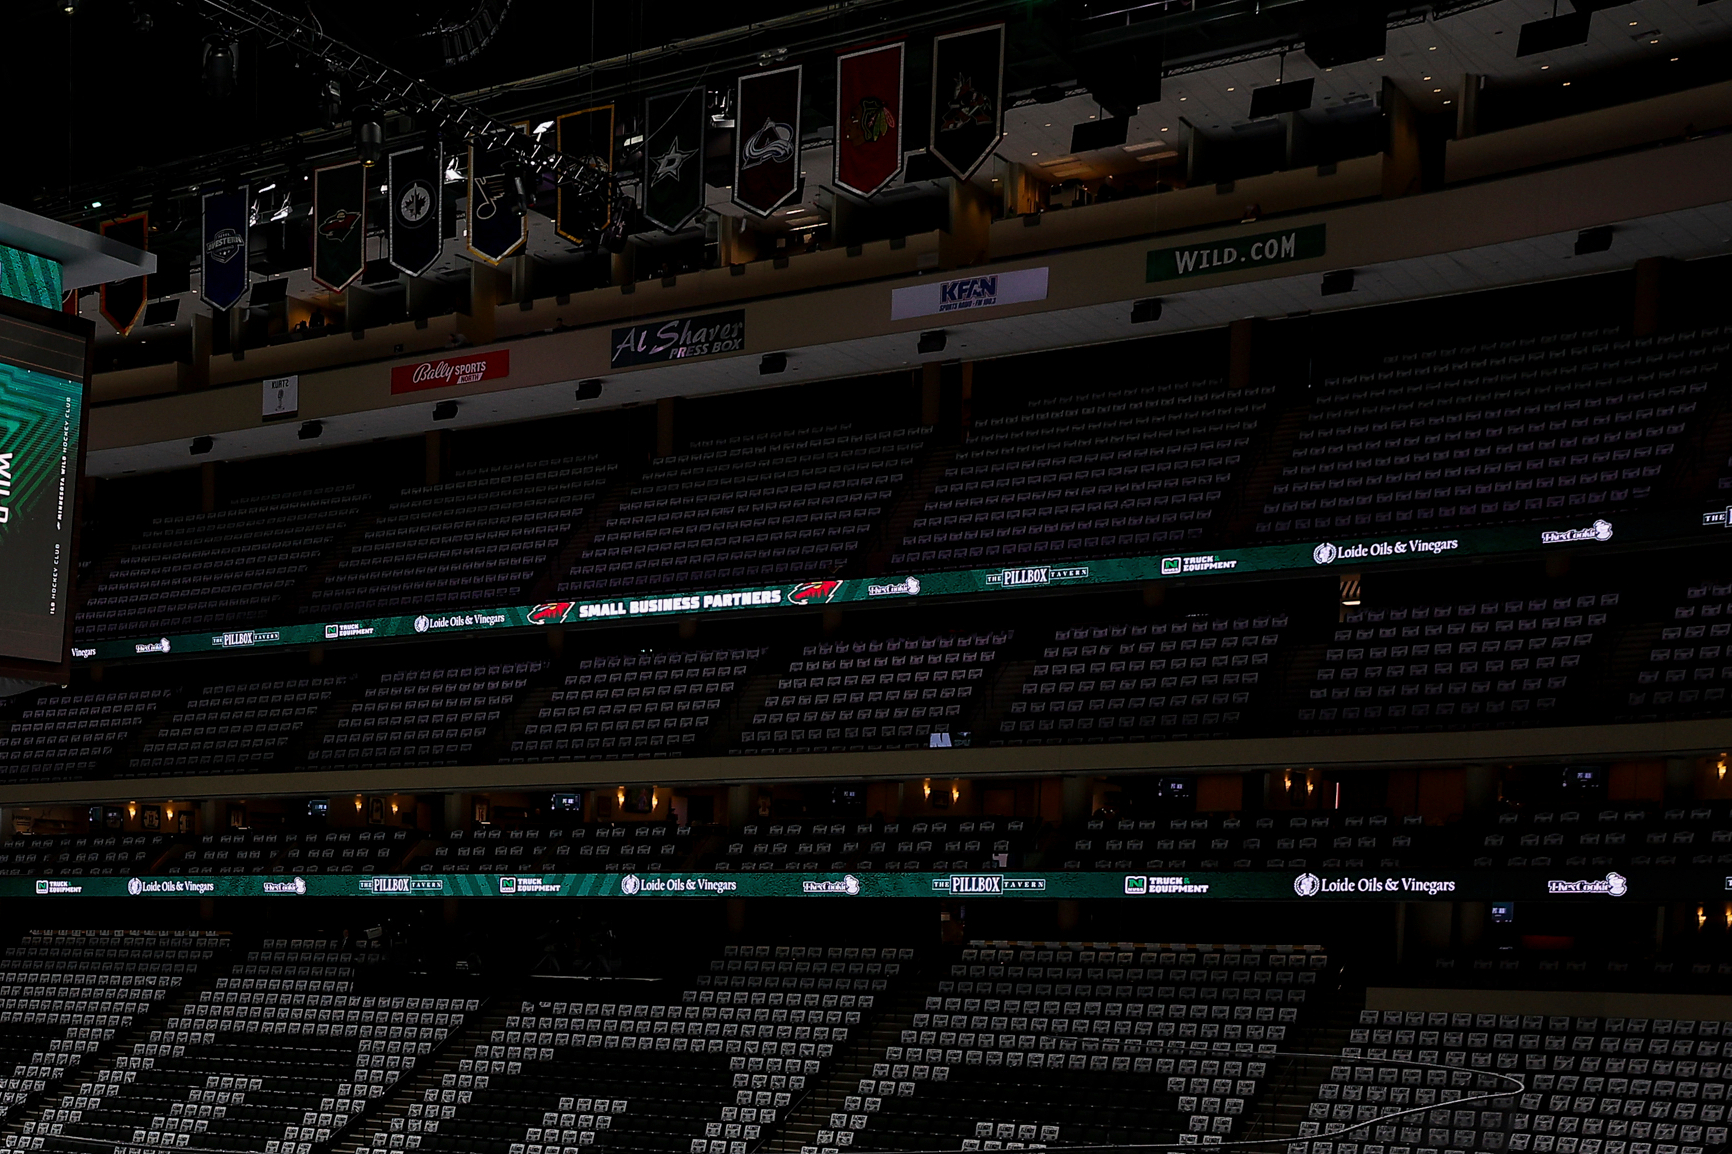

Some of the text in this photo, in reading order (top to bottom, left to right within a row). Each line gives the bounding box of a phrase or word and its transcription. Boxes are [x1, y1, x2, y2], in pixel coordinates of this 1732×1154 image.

[1174, 232, 1296, 276] WILD.COM
[941, 276, 997, 303] KFAN
[649, 319, 744, 357] Shaver
[668, 337, 741, 360] PRESS BOX
[412, 360, 487, 384] Bally SPORTS
[1704, 512, 1726, 523] THE
[1337, 537, 1458, 559] Loide Oils & Vinegars
[1183, 559, 1237, 572] EQUIPMENT
[1003, 568, 1047, 586] PILLBOX
[579, 590, 782, 618] SMALL BUSINESS PARTNERS
[373, 878, 410, 892] PILLBOX
[641, 878, 737, 894] Loide Oils & Vinegars
[952, 877, 1001, 892] PILLBOX
[1004, 881, 1044, 889] TAVERN
[1149, 877, 1183, 885] TRUCK
[1149, 884, 1209, 893] EQUIPMENT
[1321, 877, 1456, 895] Loide Oils & Vinegars
